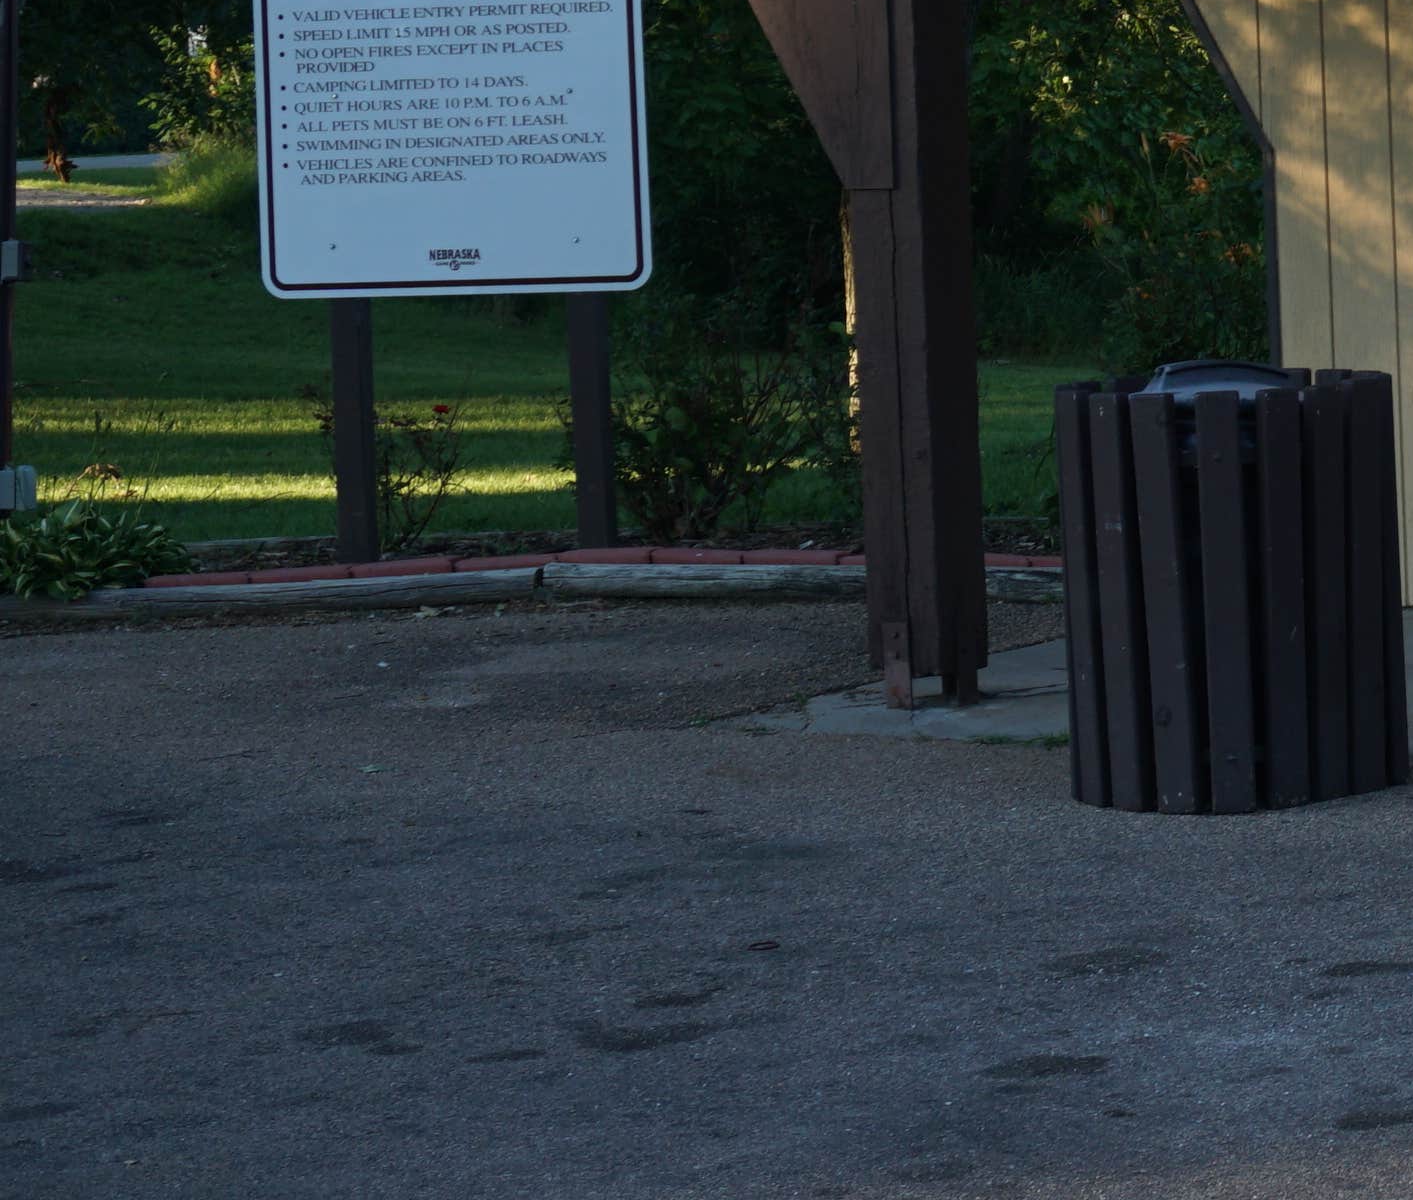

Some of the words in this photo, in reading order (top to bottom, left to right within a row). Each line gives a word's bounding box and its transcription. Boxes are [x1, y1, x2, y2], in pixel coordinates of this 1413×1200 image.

[293, 11, 340, 22] VALID
[344, 8, 409, 20] VEHICLE
[413, 7, 464, 18] ENTRY
[469, 5, 526, 16] PERMIT
[531, 2, 613, 15] REQUIRED.
[294, 30, 342, 41] SPEED
[347, 28, 391, 40] LIMIT
[396, 27, 411, 38] 15
[415, 27, 450, 37] MPH
[454, 26, 476, 36] OR
[482, 25, 501, 35] AS
[506, 23, 572, 34] POSTED.
[296, 49, 318, 59] NO
[322, 48, 363, 59] OPEN
[369, 46, 412, 57] FIRES
[417, 44, 476, 56] EXCEPT
[482, 44, 498, 54] IN
[502, 42, 563, 53] PLACES
[297, 62, 375, 73] PROVIDED
[294, 81, 366, 93] CAMPING
[370, 79, 434, 91] LIMITED
[441, 78, 459, 88] TO
[466, 78, 479, 88] 14
[484, 76, 528, 87] DAYS.
[294, 102, 343, 115] QUIET
[348, 101, 402, 111] HOURS
[407, 99, 439, 110] ARE
[446, 99, 460, 108] 10
[464, 98, 493, 108] P.M.
[497, 97, 518, 107] TO
[522, 97, 531, 106] 6
[535, 96, 568, 106] A.M.
[298, 122, 328, 132] ALL
[332, 120, 369, 131] PETS
[374, 119, 417, 130] MUST
[424, 118, 443, 128] BE
[447, 118, 470, 128] ON
[475, 118, 483, 127] 6
[487, 116, 510, 127] FT.
[512, 115, 568, 126] LEASH.
[297, 140, 381, 151] SWIMMING
[386, 139, 400, 149] IN
[406, 136, 503, 148] DESIGNATED
[507, 134, 558, 145] AREAS
[562, 133, 606, 144] ONLY.
[297, 159, 372, 170] VEHICLES
[378, 158, 408, 168] ARE
[412, 156, 493, 167] CONFINED
[496, 155, 518, 165] TO
[522, 152, 606, 164] ROADWAYS
[302, 174, 335, 184] AND
[339, 172, 408, 184] PARKING
[412, 171, 466, 182] AREAS.
[430, 248, 480, 261] NEBRASKA
